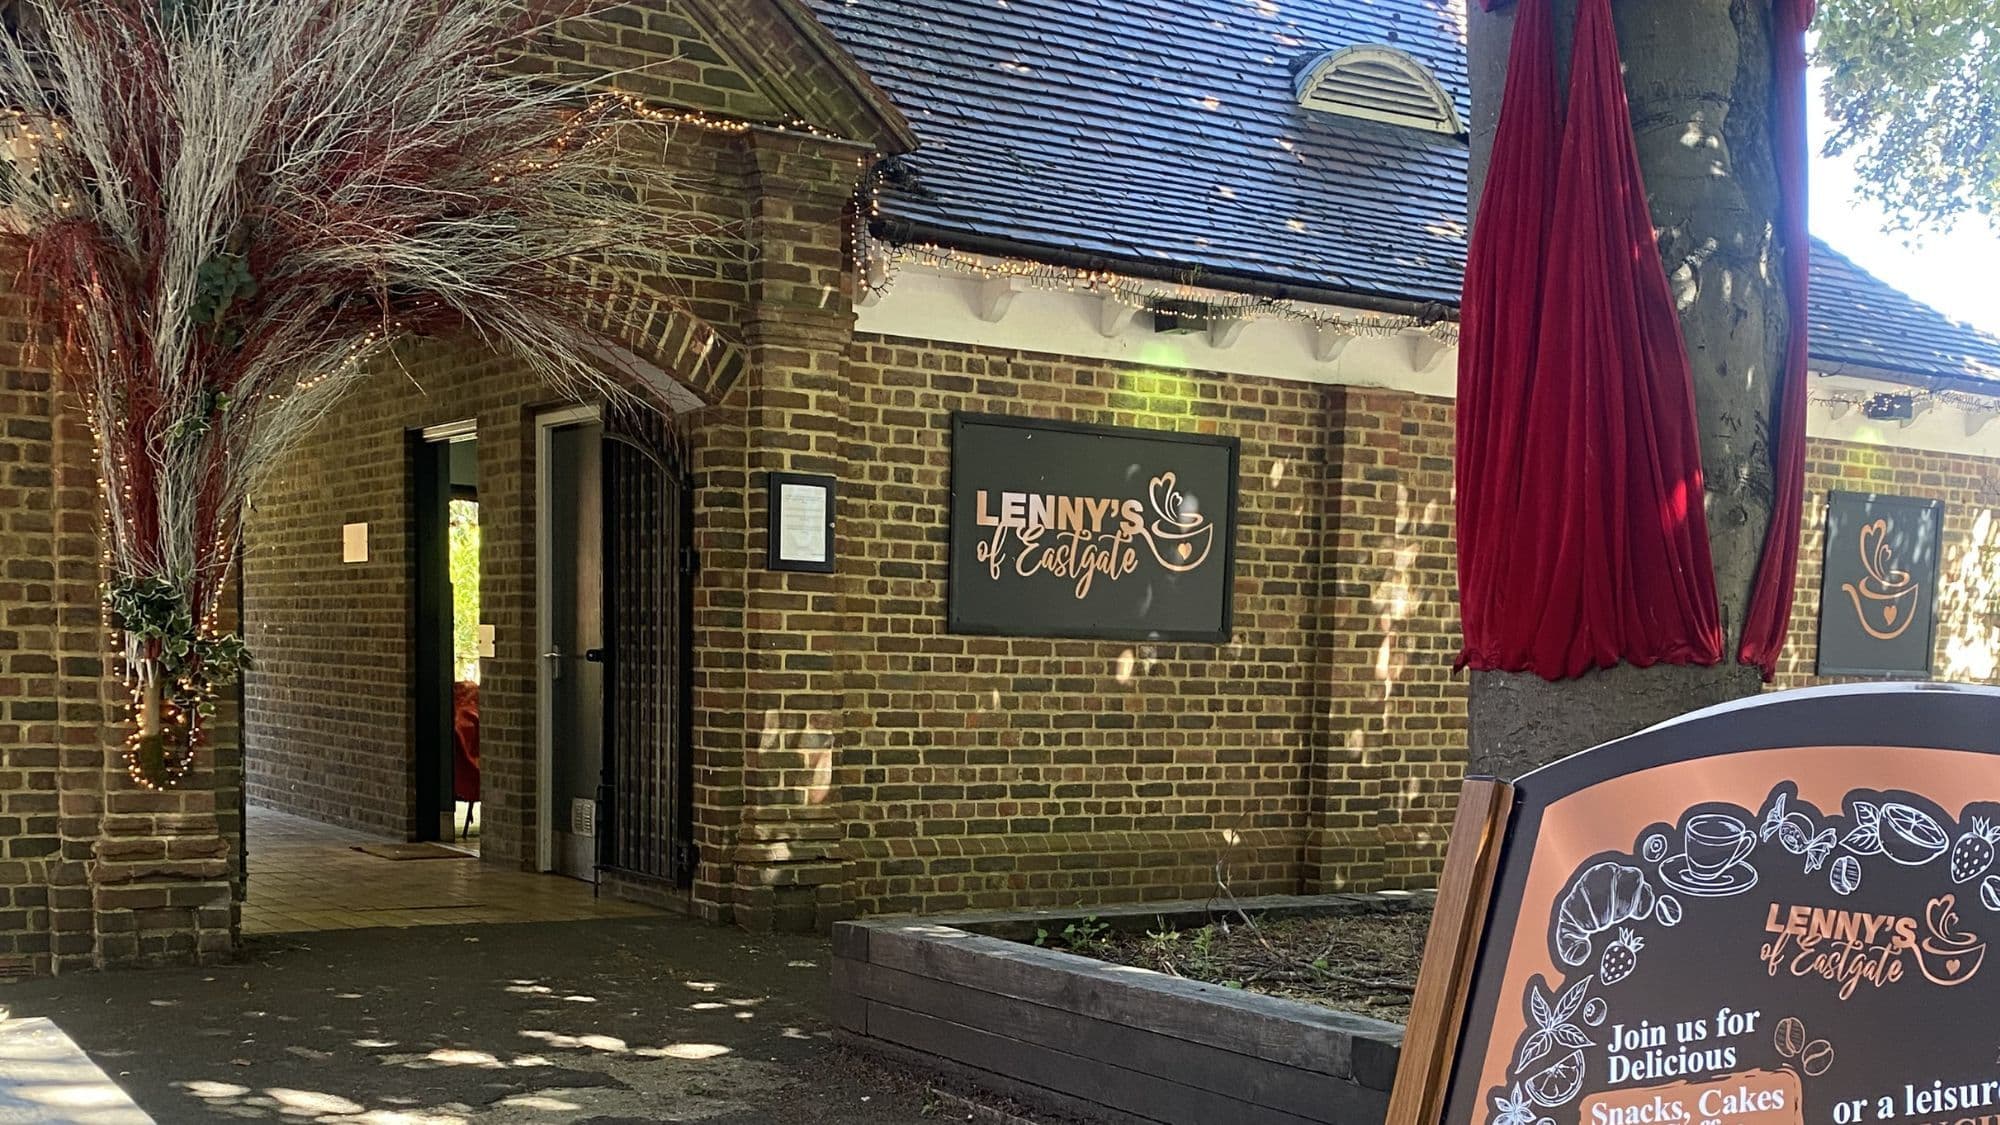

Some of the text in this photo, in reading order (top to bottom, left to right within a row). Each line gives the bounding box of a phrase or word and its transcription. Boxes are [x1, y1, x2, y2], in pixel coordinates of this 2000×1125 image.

[976, 490, 1144, 535] LENNY'S
[976, 522, 1139, 600] of Eastgate
[1765, 902, 1918, 949] LENNY'S
[1760, 932, 1904, 1001] of Eastgate
[1607, 1007, 1761, 1053] Join us for
[1607, 1046, 1737, 1084] Delicious
[1591, 1086, 1785, 1125] Snacks, Cakes
[1833, 1099, 1868, 1125] or
[1877, 1096, 1895, 1120] a
[1904, 1079, 2000, 1116] leisur
